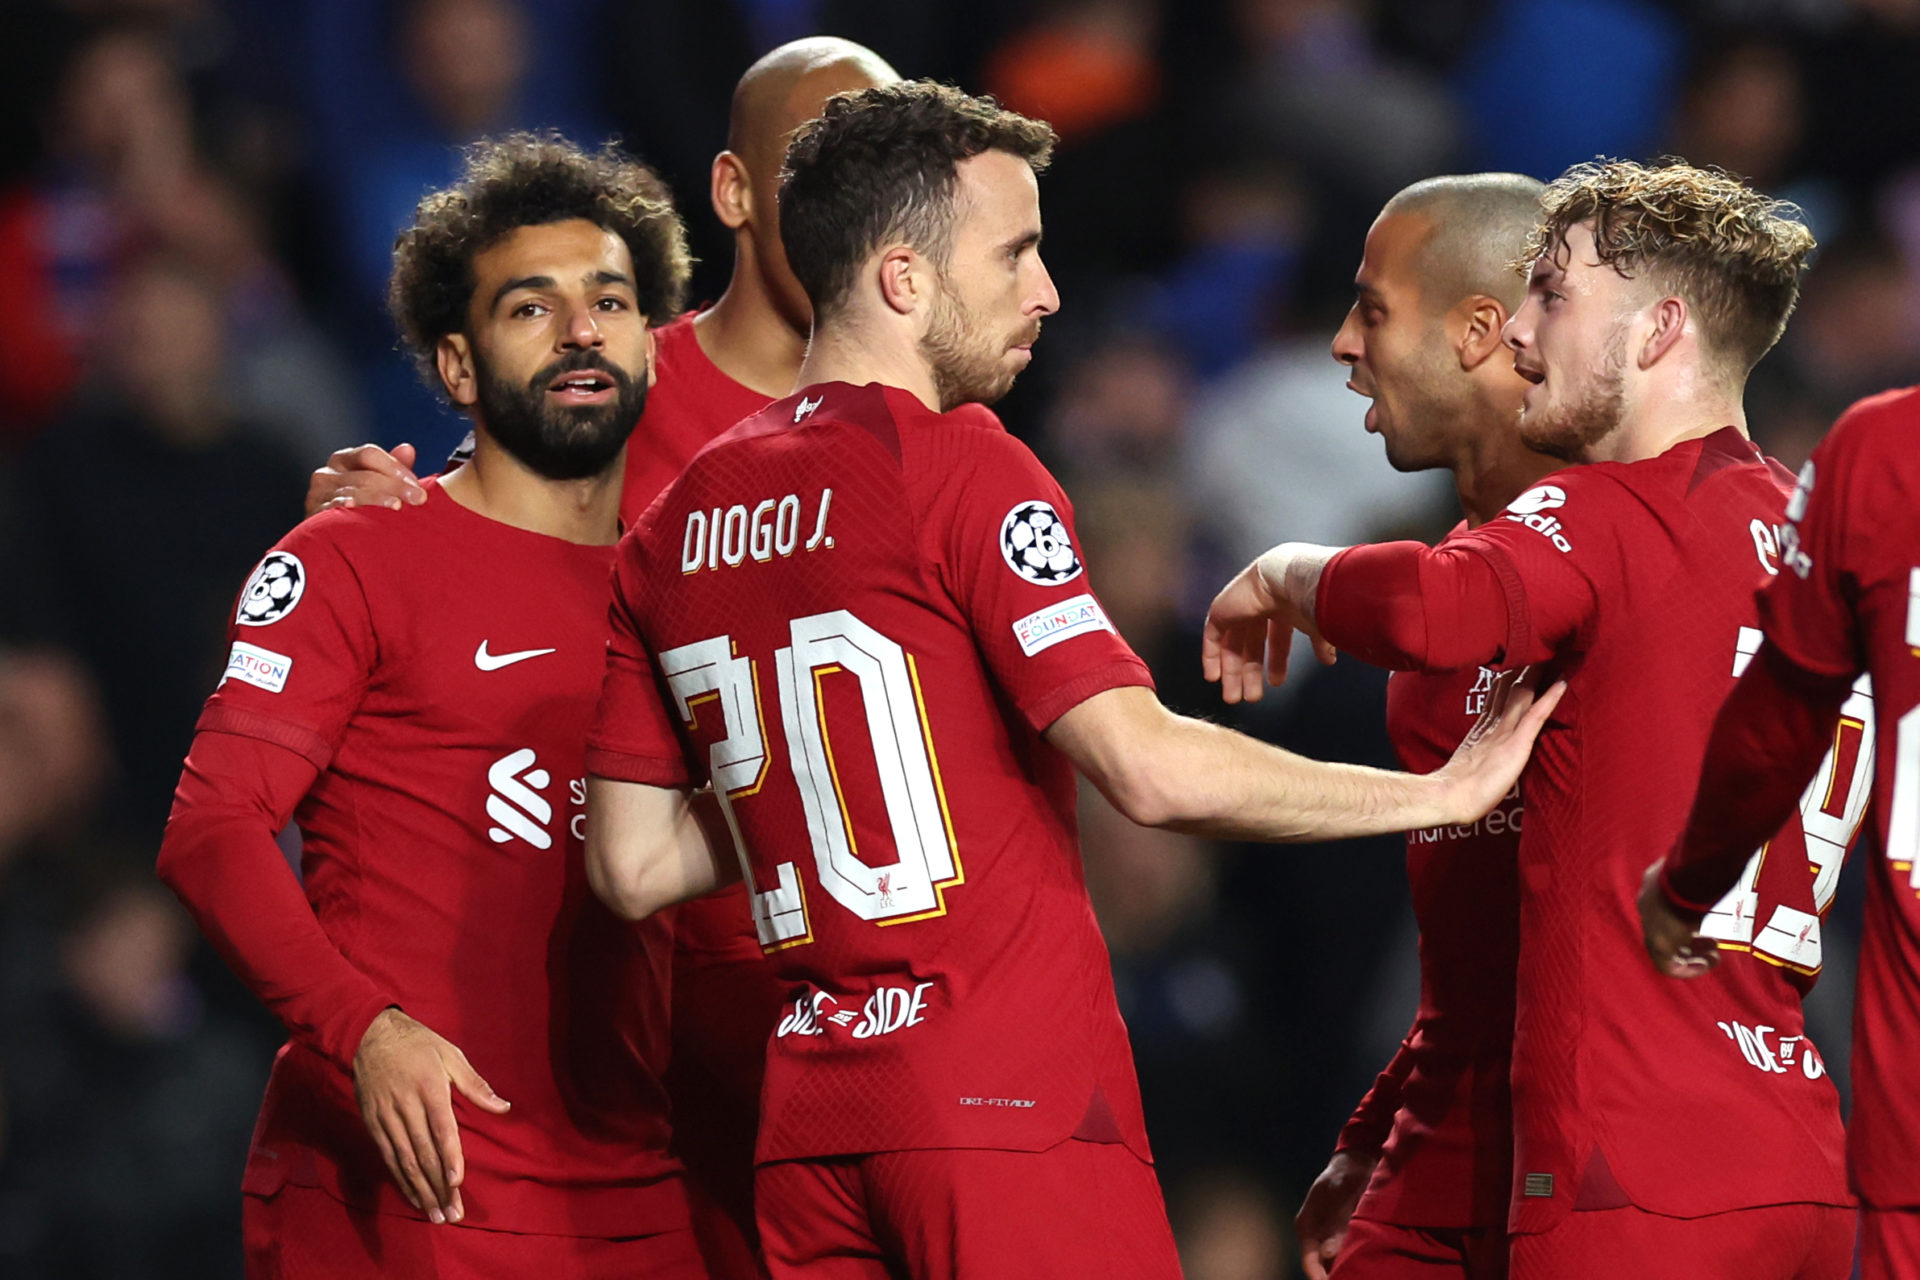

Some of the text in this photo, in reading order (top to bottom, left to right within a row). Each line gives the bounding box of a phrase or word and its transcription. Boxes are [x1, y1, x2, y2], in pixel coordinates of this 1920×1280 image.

[681, 488, 835, 576] DIOGO J.
[1017, 615, 1041, 631] UEFA
[658, 609, 965, 954] 20
[852, 982, 934, 1039] SIDE
